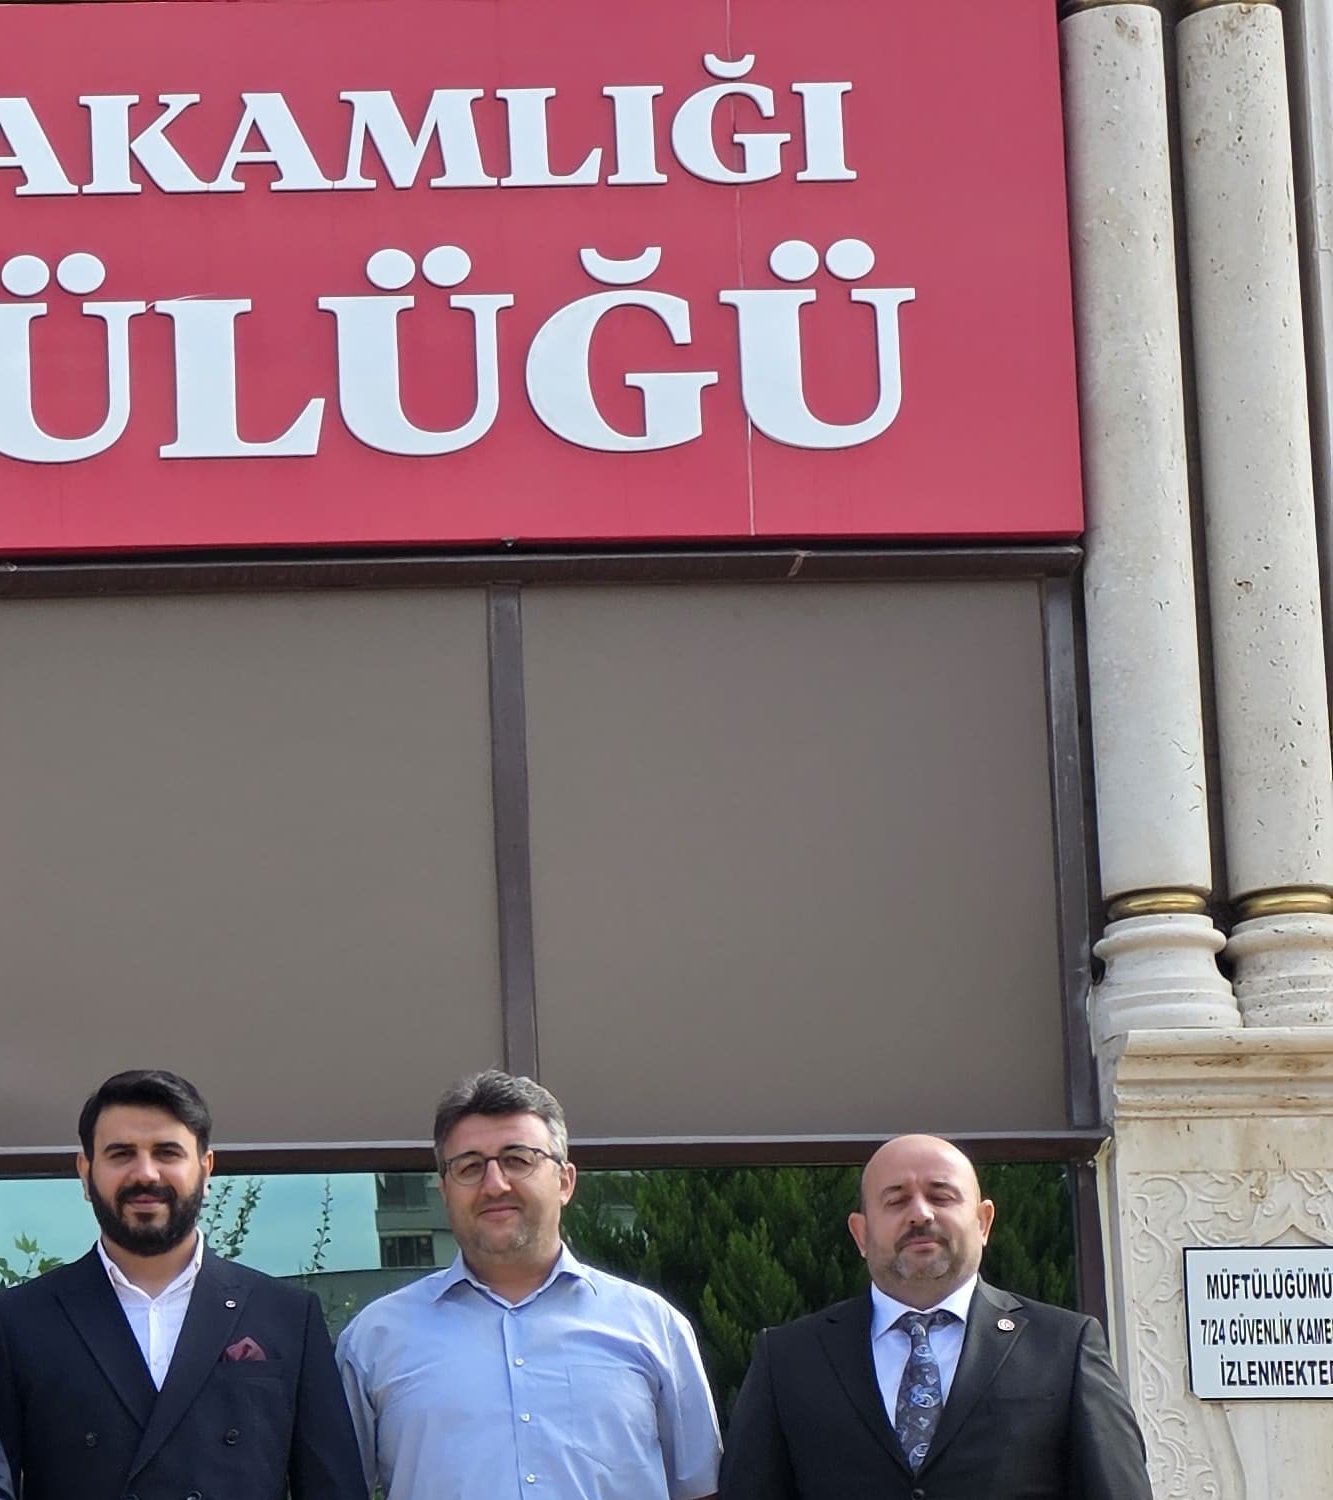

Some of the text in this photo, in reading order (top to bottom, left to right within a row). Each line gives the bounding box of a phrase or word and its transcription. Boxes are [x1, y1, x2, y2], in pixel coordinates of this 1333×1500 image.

[1206, 1267, 1333, 1300] MÜFTÜLÜĞÜMÜ
[1200, 1312, 1333, 1346] 7/24 GÜVENLİK KAME
